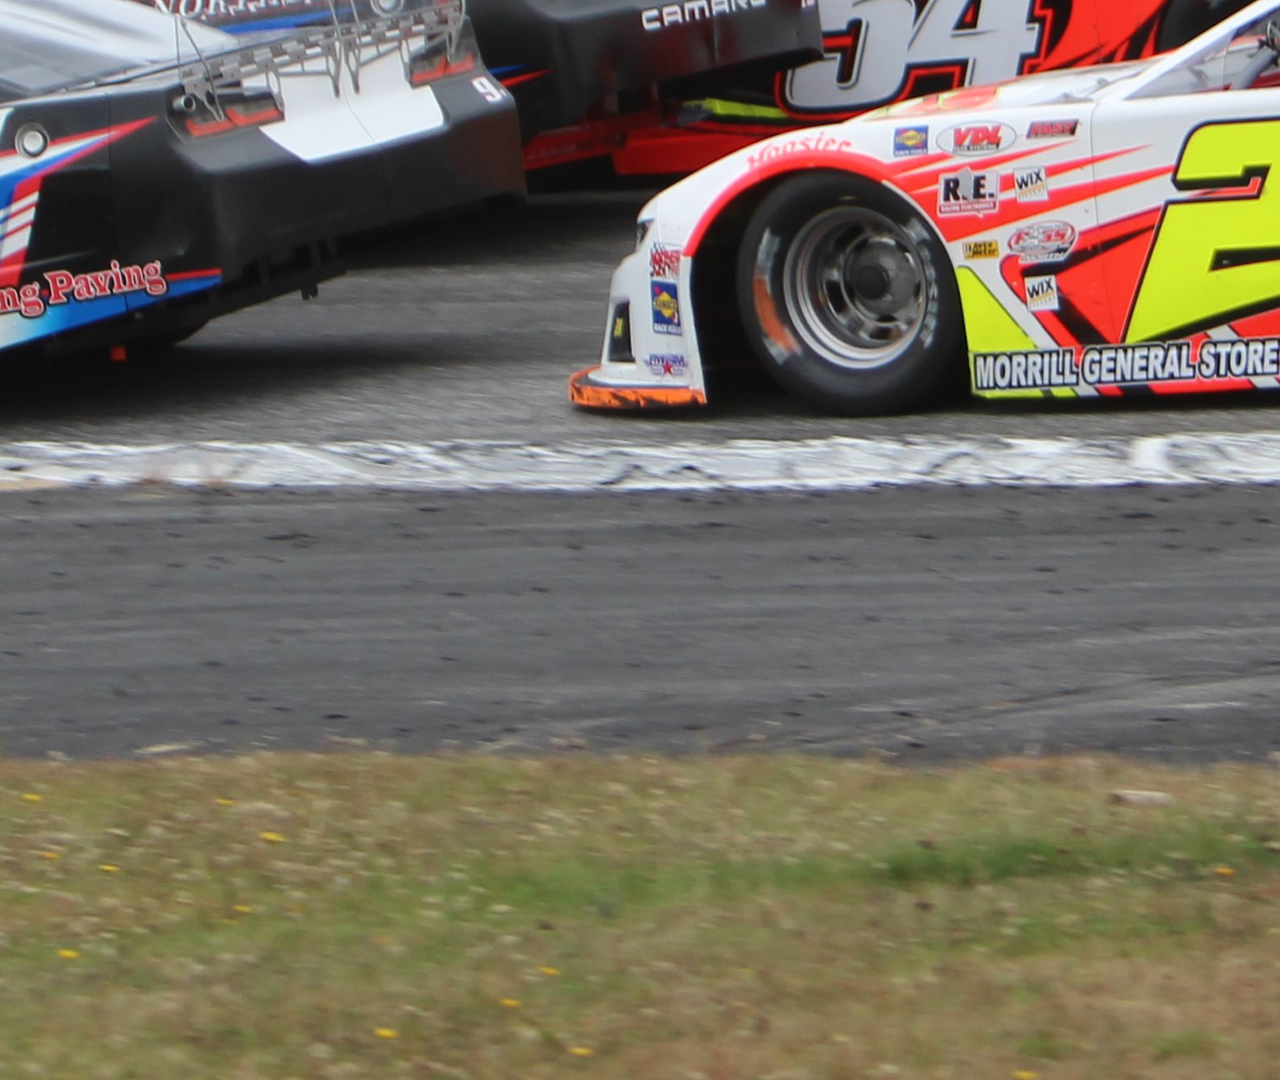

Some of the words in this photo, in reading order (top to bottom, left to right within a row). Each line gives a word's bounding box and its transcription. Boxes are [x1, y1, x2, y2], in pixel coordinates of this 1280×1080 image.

[1016, 169, 1043, 190] WIX
[43, 258, 167, 305] Paving
[1027, 277, 1054, 299] WIX
[975, 350, 1078, 390] MORRILL
[1082, 342, 1196, 386] GENERAL
[1197, 338, 1280, 378] STORE
